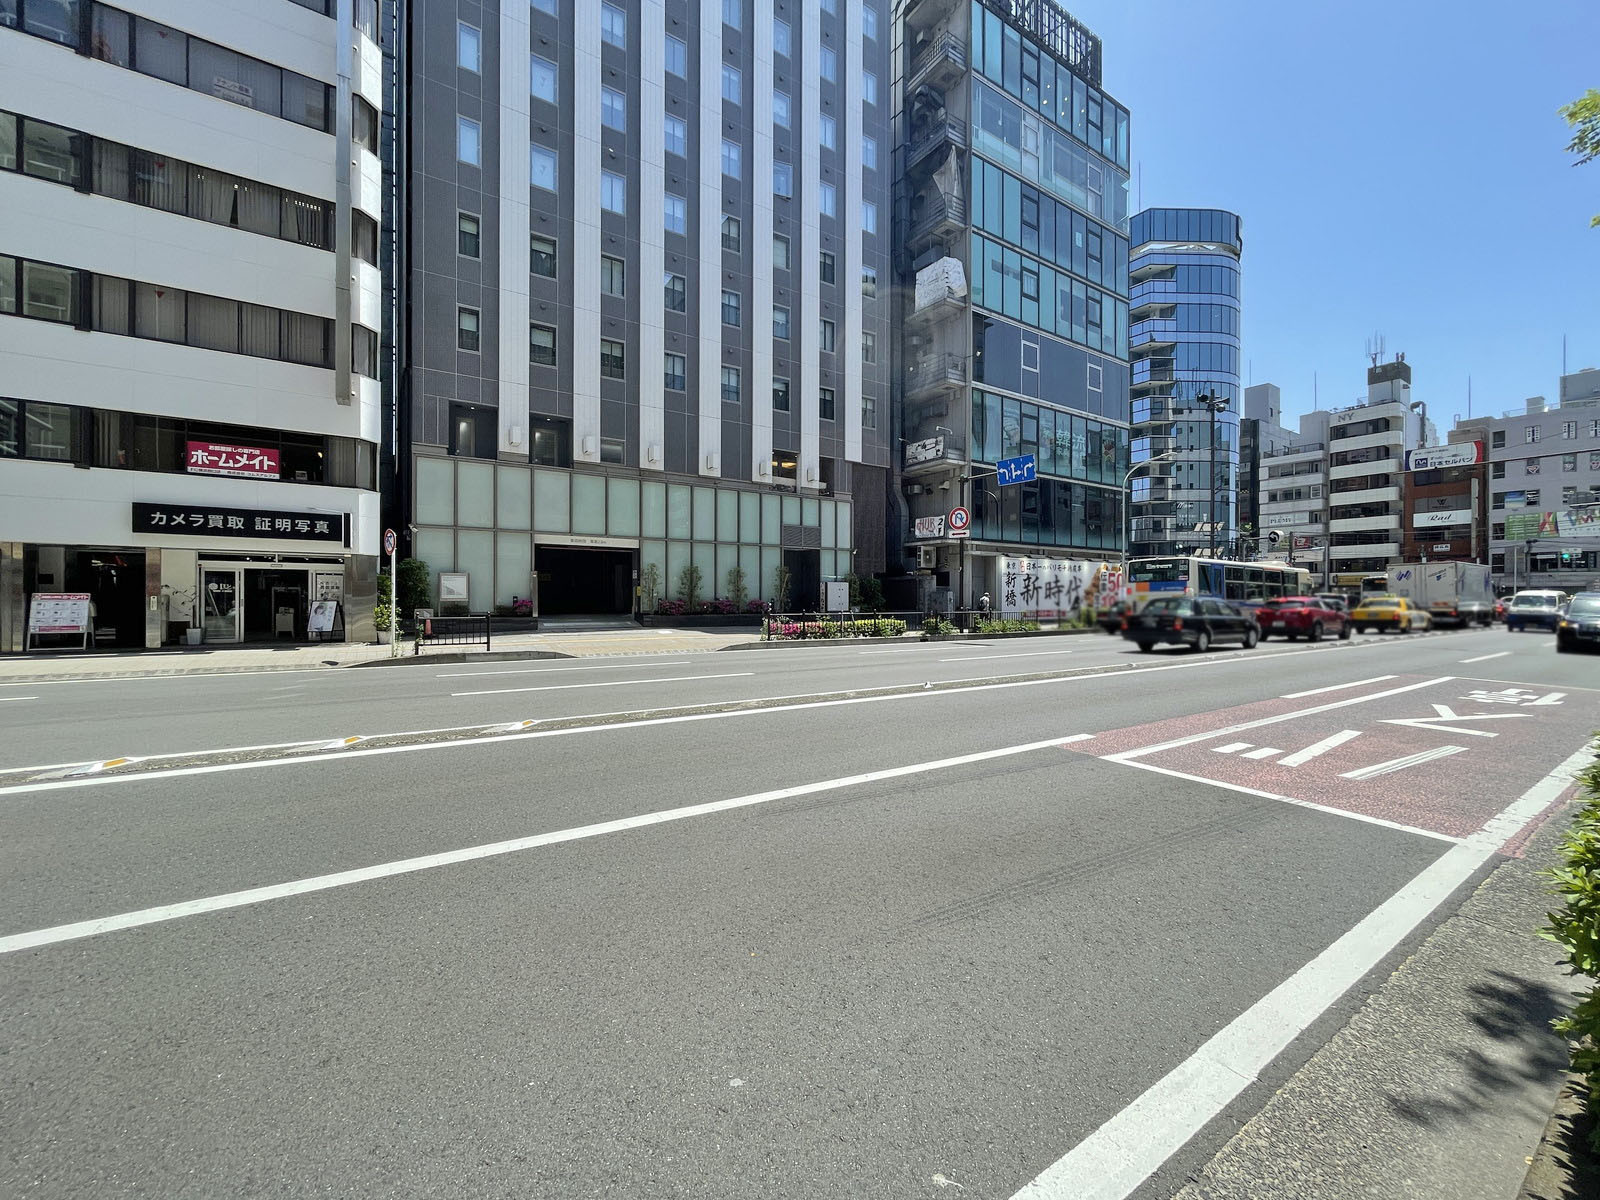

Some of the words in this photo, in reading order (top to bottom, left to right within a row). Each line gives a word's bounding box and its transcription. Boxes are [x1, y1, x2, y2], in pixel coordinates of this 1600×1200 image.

[1338, 412, 1354, 422] NY
[190, 449, 276, 470] ホームメイト
[150, 511, 245, 529] カメラ買取
[254, 516, 330, 534] 証明写真
[1005, 572, 1017, 607] 新橋
[1020, 573, 1082, 607] 新時代
